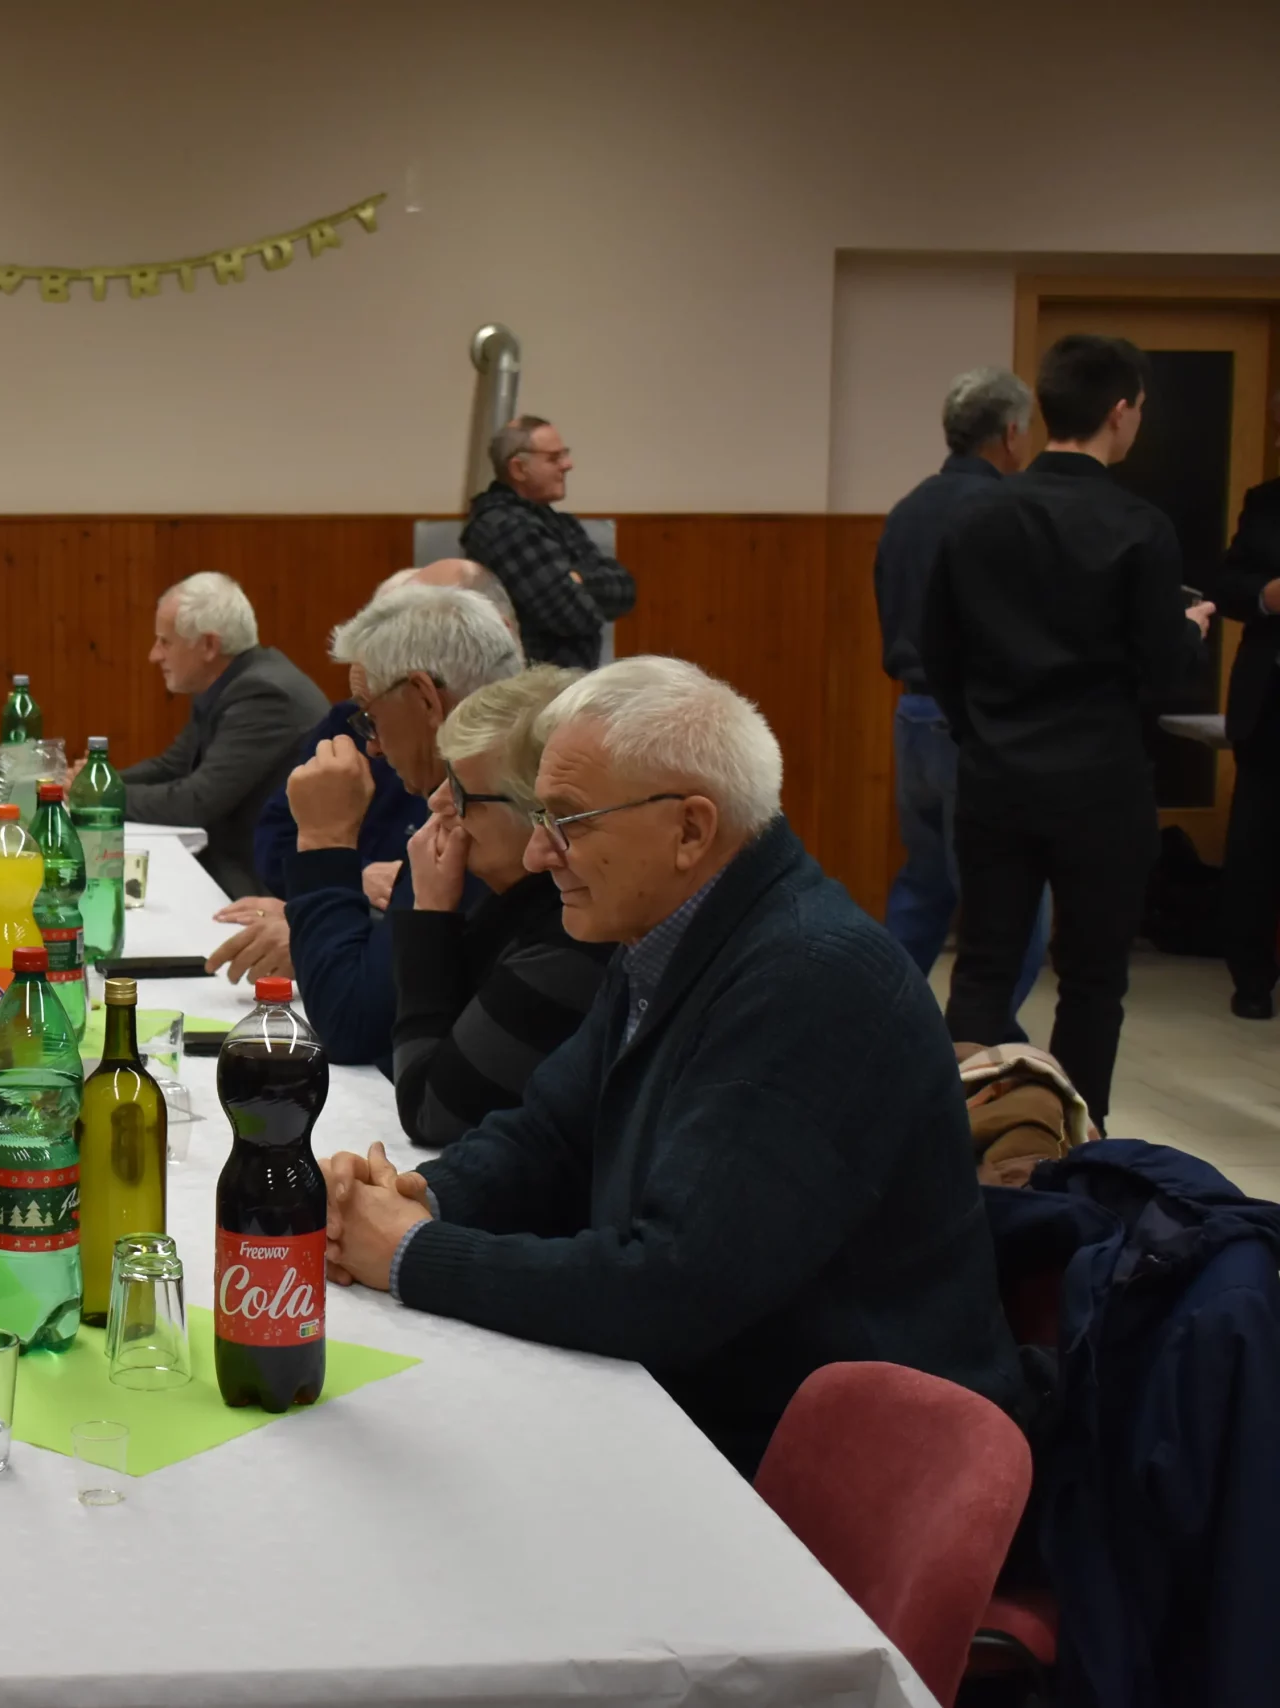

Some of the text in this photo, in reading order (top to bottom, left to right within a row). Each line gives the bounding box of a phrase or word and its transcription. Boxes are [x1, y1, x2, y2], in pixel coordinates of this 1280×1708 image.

[40, 203, 379, 302] BIRTHDAY
[239, 1240, 290, 1261] Freeway
[220, 1264, 315, 1320] Cola
